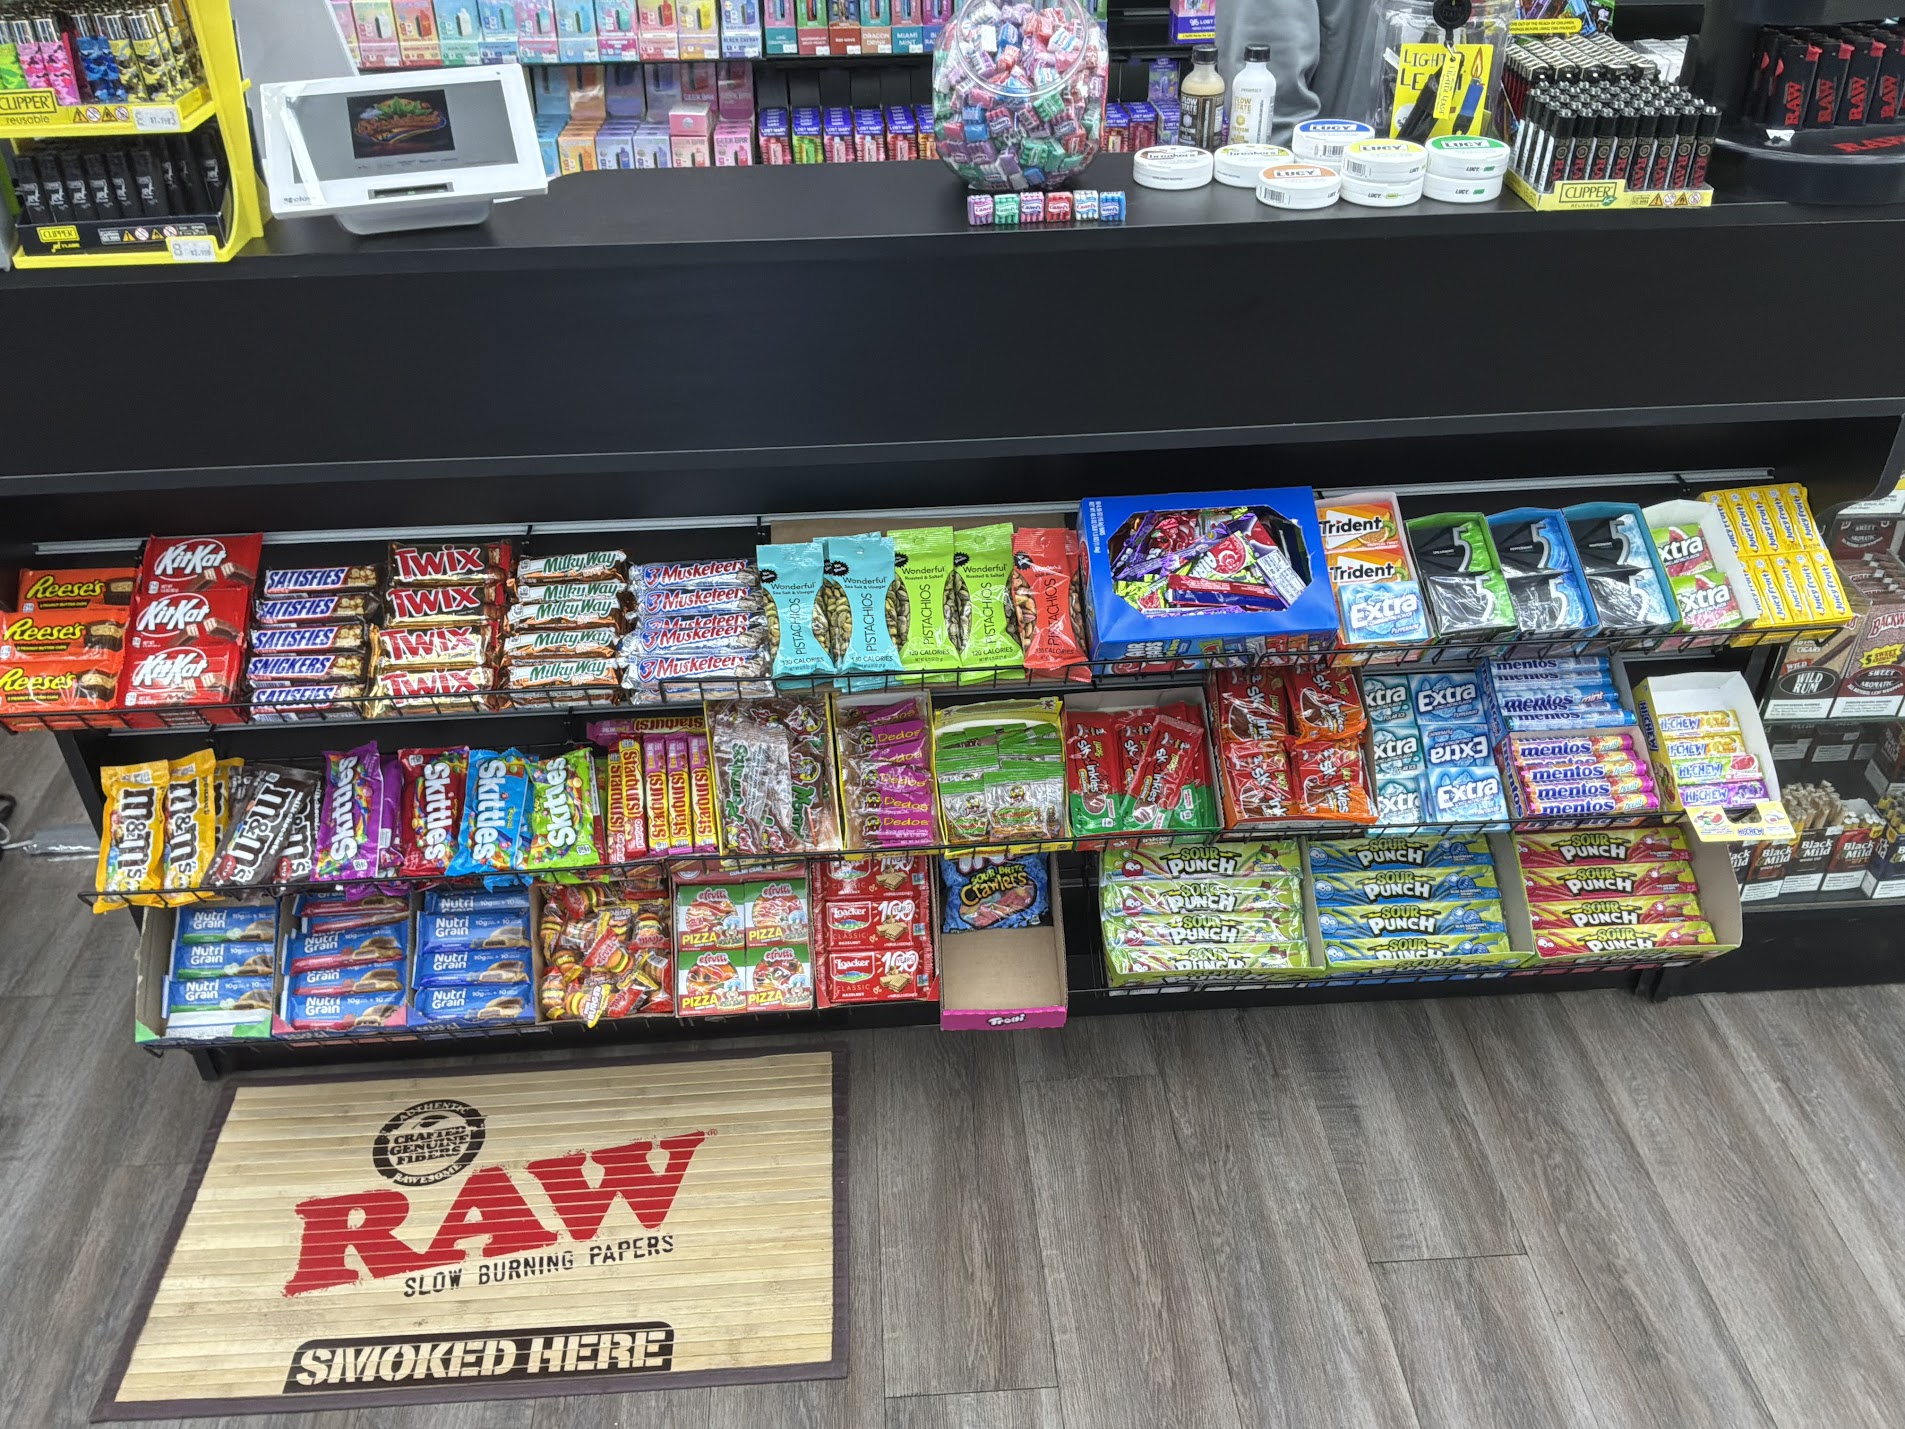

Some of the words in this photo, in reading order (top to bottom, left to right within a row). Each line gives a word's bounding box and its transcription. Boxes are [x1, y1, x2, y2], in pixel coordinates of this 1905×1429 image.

[1785, 81, 1803, 126] RAW
[1818, 79, 1834, 123] RAW
[6, 114, 50, 125] reusable
[1362, 144, 1404, 152] LUCY
[1444, 140, 1483, 148] LUCY
[1564, 185, 1614, 201] CLIPPER
[42, 228, 76, 239] CLIPPER
[1319, 516, 1383, 535] Trident
[1453, 526, 1471, 573] 5
[1659, 536, 1704, 565] xtra
[543, 555, 586, 577] Milky
[587, 549, 617, 568] Way
[902, 566, 945, 576] Wonderful
[963, 564, 1007, 574] Wonderful
[1330, 562, 1395, 582] Trident
[267, 567, 344, 590] SATISFIES
[644, 566, 662, 586] 3
[662, 560, 746, 584] Musketeers
[905, 574, 923, 582] Roasted
[26, 575, 105, 600] Reese's
[543, 584, 587, 601] Milky
[587, 581, 619, 598] Way
[771, 582, 816, 592] Wonderful
[797, 590, 815, 598] Vinegar
[645, 594, 662, 614] 3
[663, 587, 750, 611] Musketeers
[1475, 575, 1495, 623] 5
[920, 583, 935, 645] PISTACHIOS
[980, 582, 998, 645] PISTACHIOS
[1350, 594, 1418, 629] Extra
[3, 617, 85, 641] Reese's
[788, 597, 807, 655] PISTACHIOS
[860, 592, 878, 654] PISTACHIOS
[253, 626, 335, 649] SATISFIES
[642, 631, 660, 652] 3
[660, 625, 747, 649] Musketeers
[983, 647, 1014, 657] CALORIES
[1044, 648, 1074, 657] CALORIES
[1796, 645, 1822, 654] CIGARS
[248, 656, 331, 677] SNICKERS
[863, 655, 893, 664] CALORIES
[1496, 658, 1558, 671] mentos
[1863, 655, 1872, 665] 5
[0, 667, 77, 692] Reese's
[1797, 673, 1824, 684] WILD
[1868, 669, 1896, 678] SWEET
[1792, 682, 1820, 694] RUM
[1860, 680, 1896, 689] AROMATIC
[1418, 683, 1477, 713] Extra
[1503, 694, 1574, 711] mentos
[1580, 690, 1606, 704] mint
[877, 729, 921, 743] Dedos
[1519, 742, 1592, 758] mentos
[1599, 739, 1620, 752] fruit
[1531, 765, 1605, 781] mentos
[1613, 763, 1633, 775] fruit
[1678, 763, 1722, 779] HI-CHEW
[622, 750, 644, 819] Starburst
[1536, 783, 1611, 801] mentos
[1618, 780, 1640, 793] fruit
[542, 757, 577, 848] Skittles
[884, 795, 930, 811] Dedos
[1436, 777, 1499, 814] Extra
[1684, 787, 1729, 804] HI-CHEW
[330, 756, 360, 860] Skittles
[422, 761, 453, 860] Skittles
[473, 758, 507, 862] Skittles
[646, 772, 668, 840] Starburst
[669, 772, 688, 838] Starburst
[883, 815, 930, 828] Dedos
[634, 819, 644, 849] Original
[1180, 846, 1220, 861] SOUR
[1762, 846, 1793, 858] Black
[1801, 839, 1834, 850] Black
[1803, 847, 1832, 858] Mild
[1843, 840, 1875, 852] Black
[1846, 847, 1873, 860] Mild
[1168, 857, 1238, 878] PUNCH
[1765, 854, 1792, 865] Mild
[970, 871, 996, 885] SOUR
[997, 864, 1026, 877] BRITE
[960, 871, 1029, 907] Crawlers
[1179, 883, 1222, 898] SOUR
[830, 906, 866, 918] Loacker
[1168, 893, 1237, 914] PUNCH
[193, 910, 228, 923] Nutri
[193, 919, 226, 931] Grain
[682, 931, 718, 946] PIZZA
[748, 926, 783, 942] PIZZA
[832, 932, 867, 941] CLASSIC
[1170, 926, 1239, 946] PUNCH
[190, 943, 224, 956] Nutri
[190, 954, 224, 965] Grain
[834, 958, 870, 970] Loacker
[186, 979, 220, 992] Nutri
[185, 990, 219, 1002] Grain
[588, 985, 604, 1021] BURGER
[682, 993, 719, 1008] PIZZA
[748, 989, 783, 1005] PIZZA
[987, 1013, 1027, 1026] Trolli
[399, 1102, 469, 1122] AUTHENTIC
[393, 1125, 468, 1145] CRAFTED
[389, 1134, 470, 1156] GENUINE
[396, 1146, 463, 1166] FIBERS
[393, 1163, 464, 1184] RAWESOME
[281, 1131, 708, 1298] RAW
[403, 1268, 464, 1298] SLOW
[478, 1250, 575, 1286] BURNING
[590, 1233, 675, 1265] PAPERS
[295, 1338, 518, 1387] SMOKED
[527, 1331, 667, 1374] HERE
